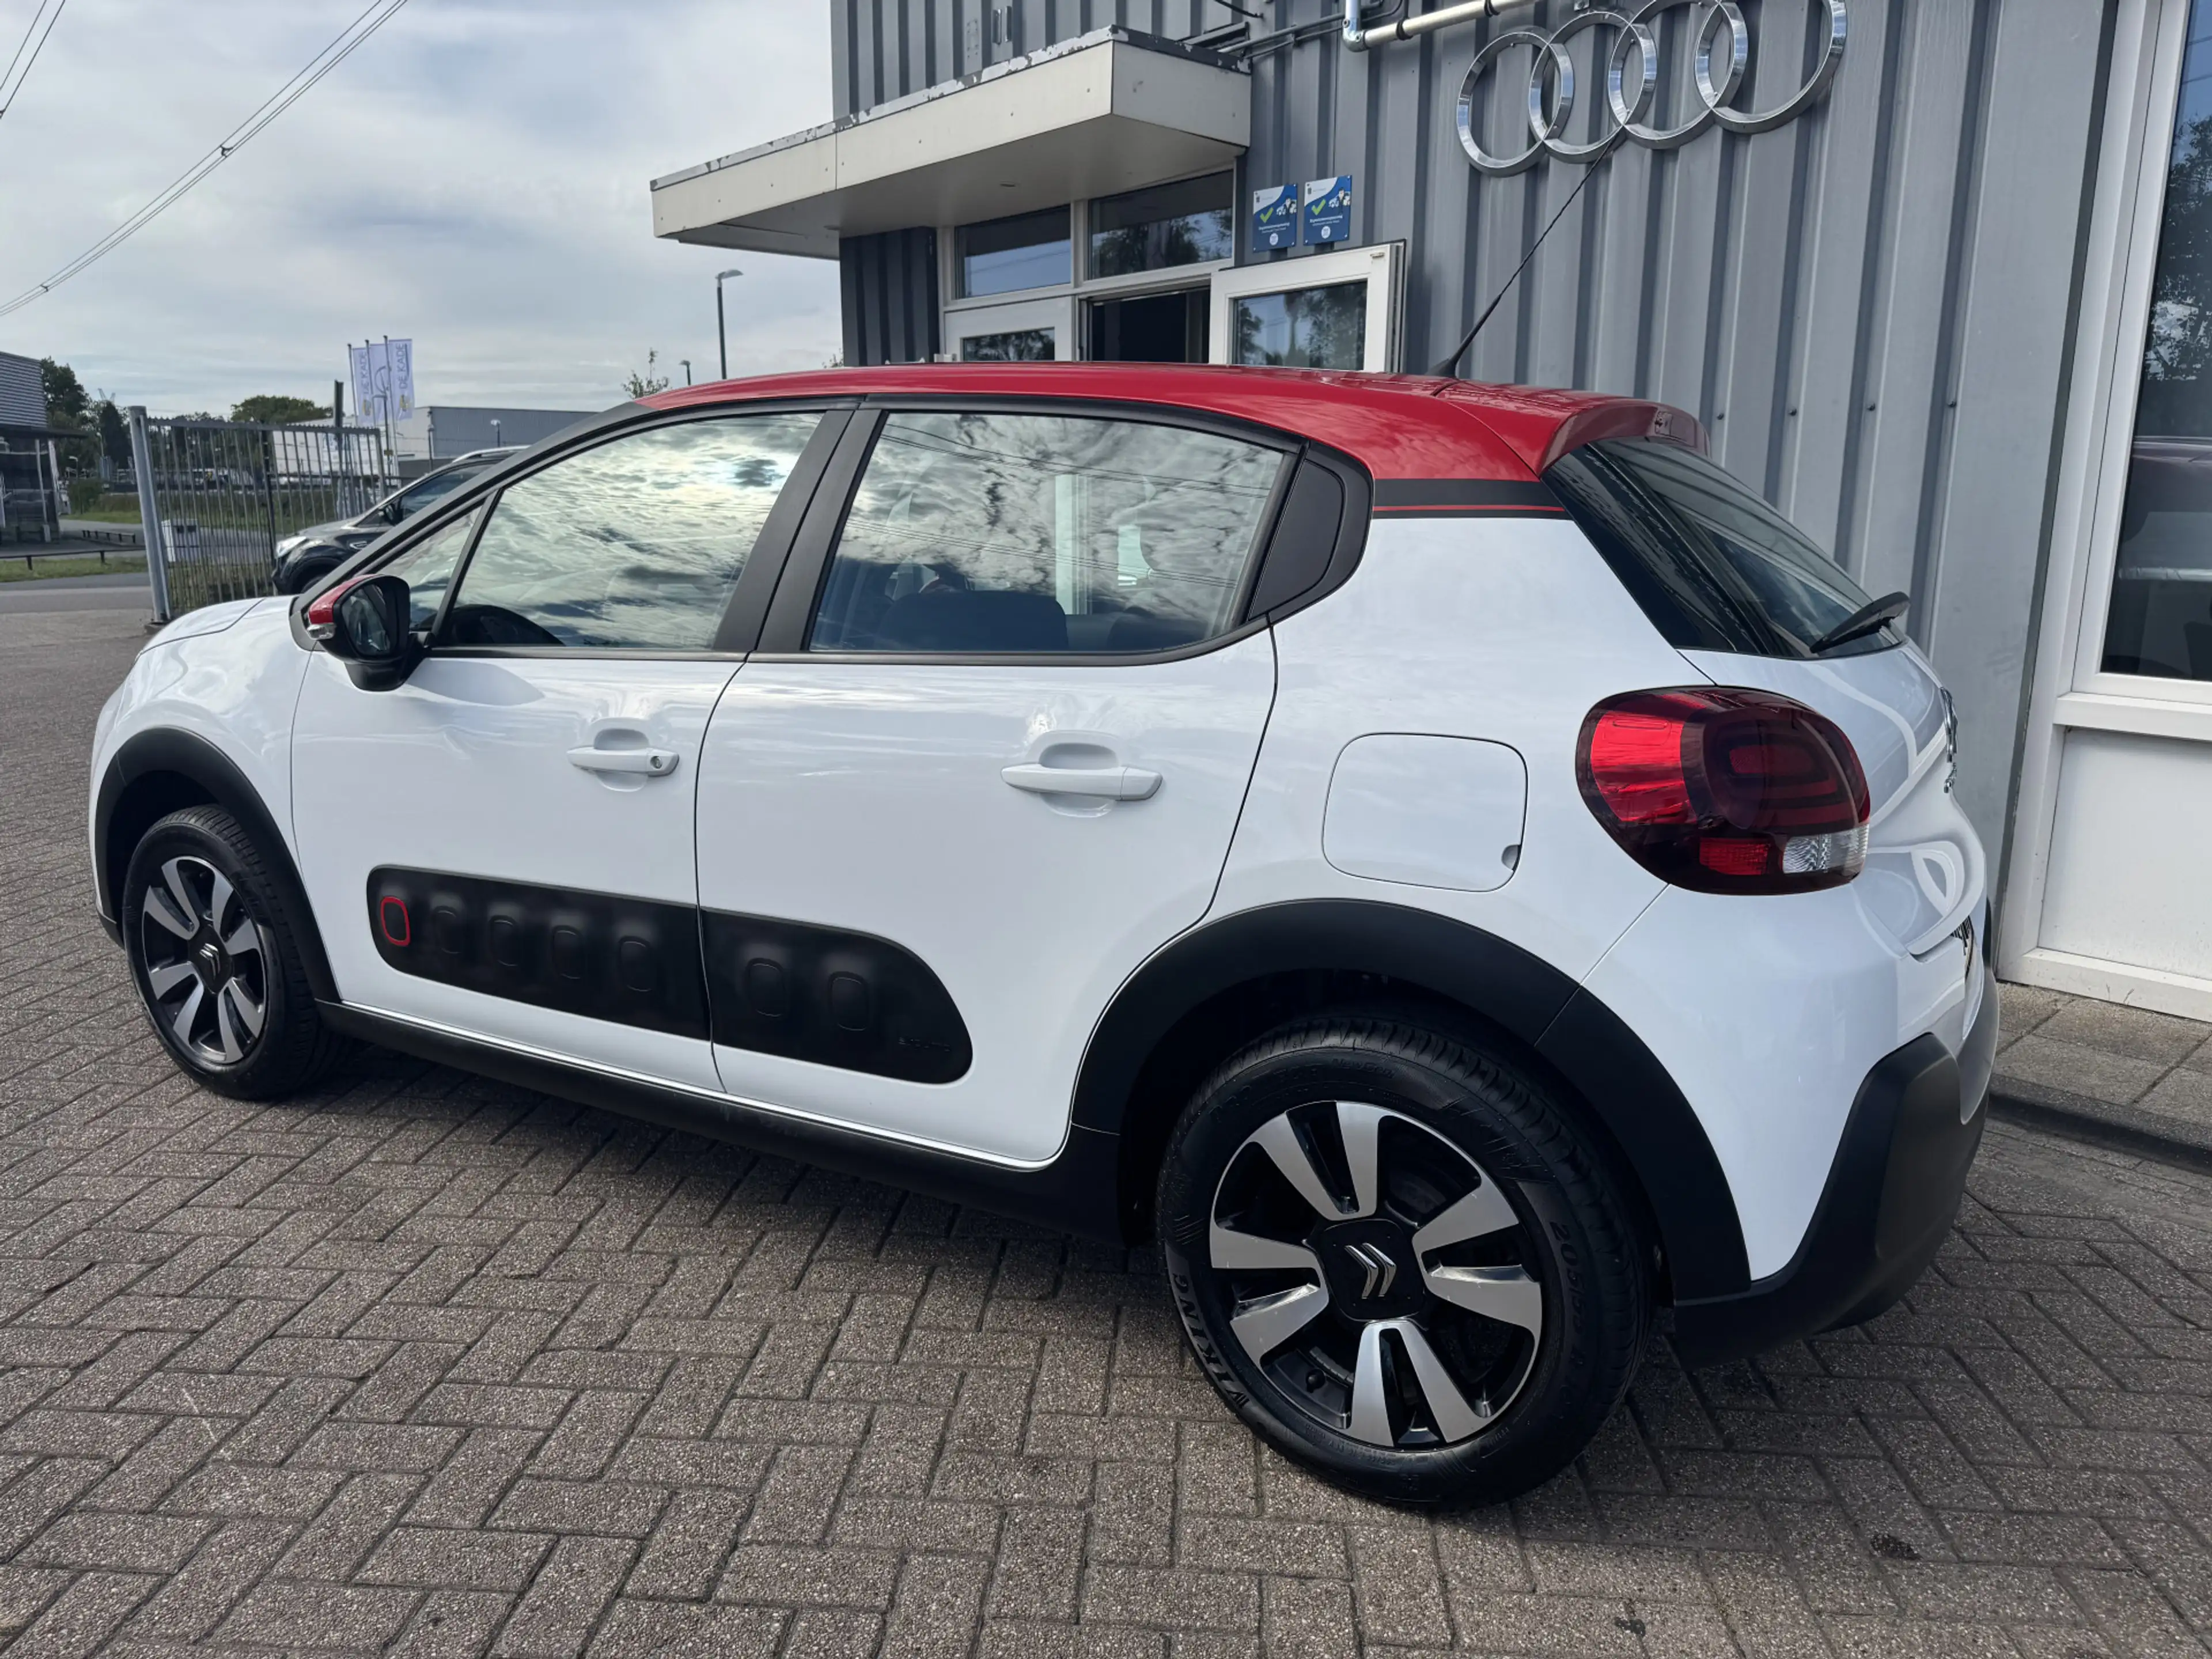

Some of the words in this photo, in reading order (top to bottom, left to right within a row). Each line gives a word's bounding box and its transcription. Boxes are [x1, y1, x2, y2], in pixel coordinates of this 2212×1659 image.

[359, 352, 368, 379] KADE
[396, 343, 406, 372] KADE
[399, 376, 407, 389] DE
[1172, 1273, 1250, 1408] VIKING
